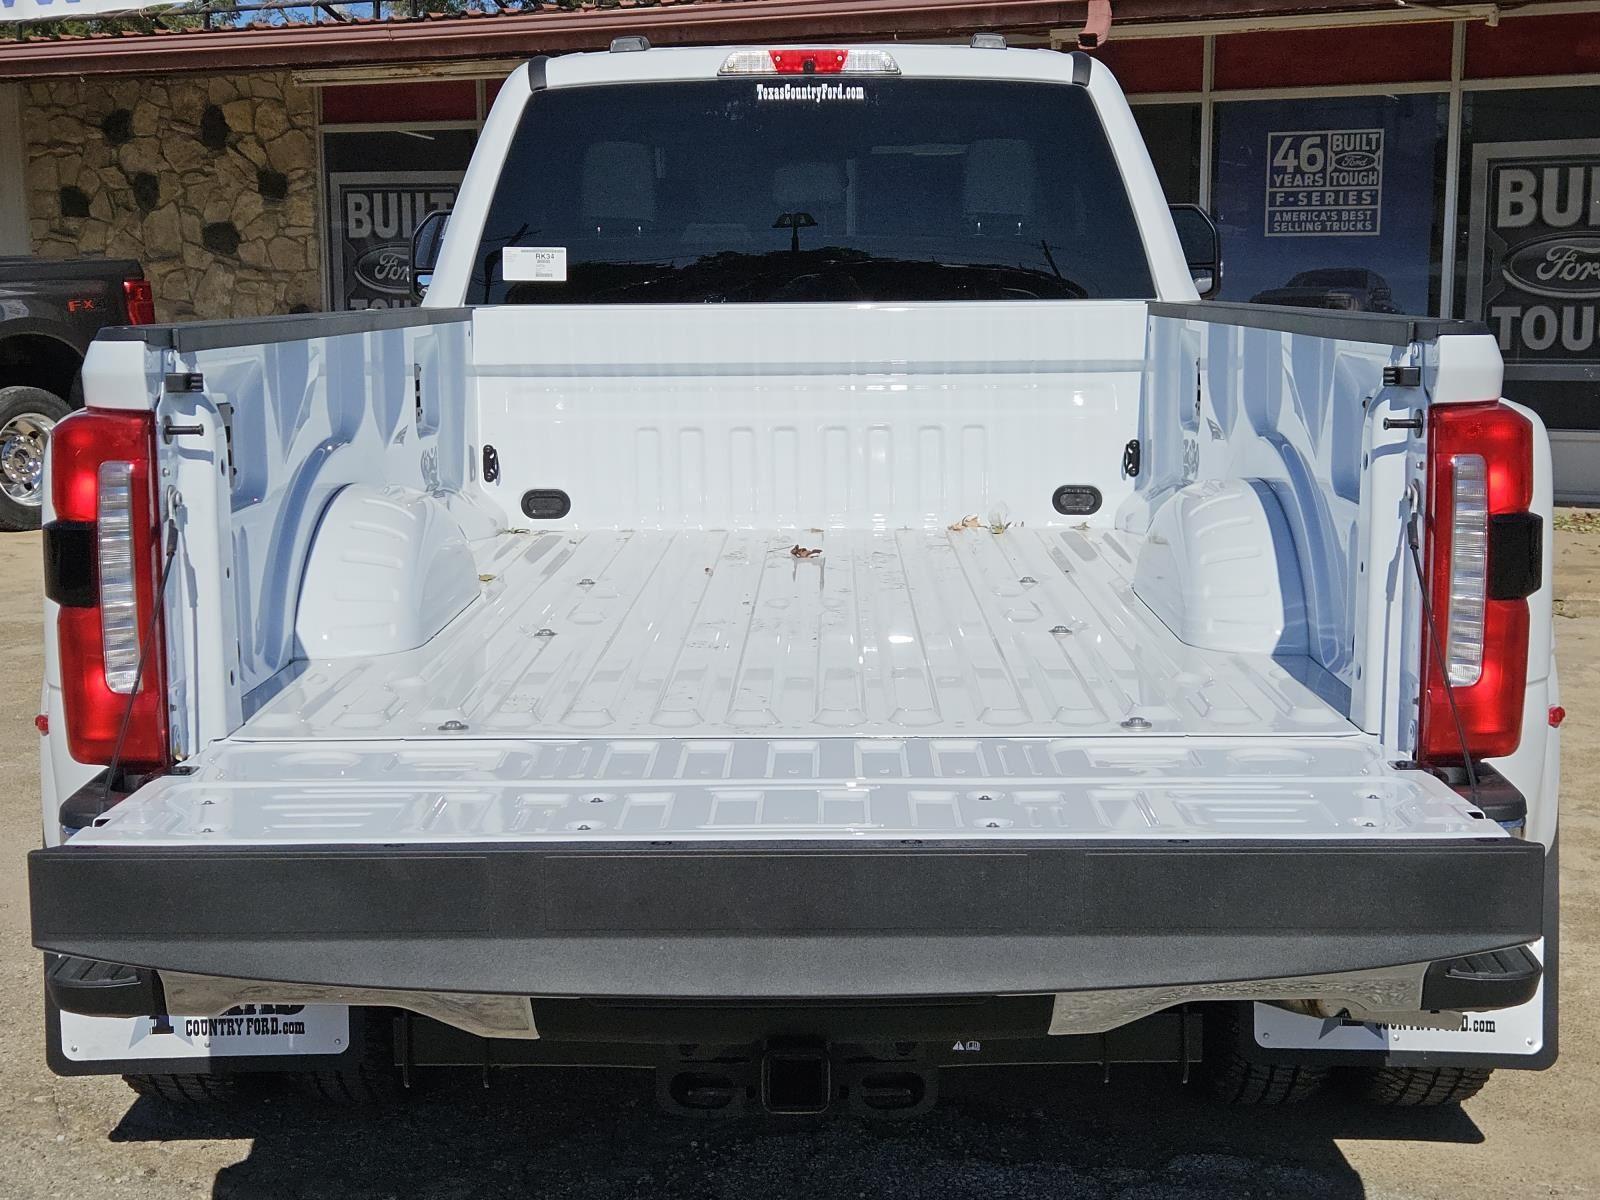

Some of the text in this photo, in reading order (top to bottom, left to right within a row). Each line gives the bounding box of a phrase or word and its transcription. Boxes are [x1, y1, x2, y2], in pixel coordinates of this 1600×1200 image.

[756, 83, 865, 103] TexasCountryFord.com
[1332, 133, 1380, 151] BUILT
[1273, 136, 1325, 173] 46
[1340, 154, 1368, 167] Ford
[1273, 173, 1324, 187] YEARS
[1331, 171, 1377, 186] TOUGH
[1275, 191, 1372, 206] F-SERIES
[1273, 210, 1372, 222] AMERICA'S BEST
[1273, 220, 1372, 232] SELLING TRUCKS
[1536, 246, 1600, 281] For
[1491, 306, 1600, 351] TOU
[185, 1018, 245, 1036] COUNTRY
[246, 1017, 306, 1036] FORD.com
